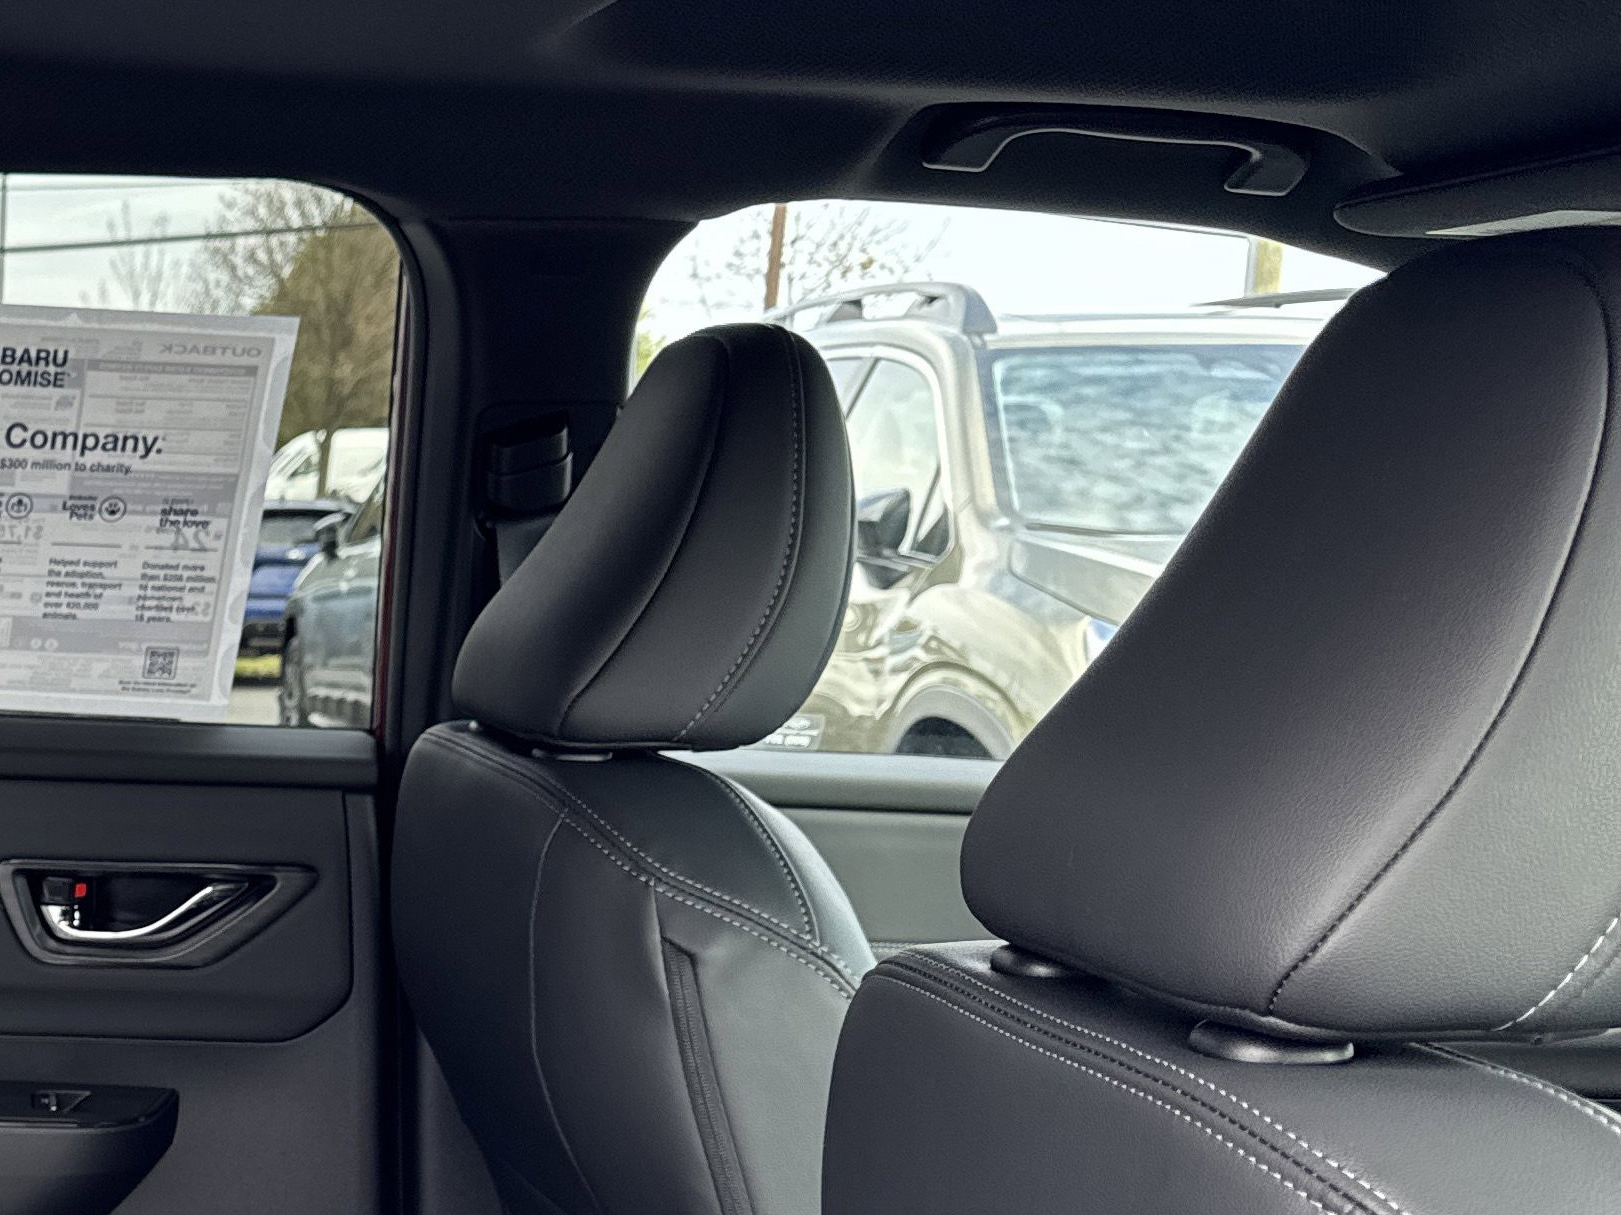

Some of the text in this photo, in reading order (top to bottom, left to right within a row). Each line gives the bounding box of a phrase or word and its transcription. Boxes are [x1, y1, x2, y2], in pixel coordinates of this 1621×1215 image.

[5, 422, 164, 460] Company.
[0, 457, 28, 471] $300
[31, 459, 71, 472] million
[75, 460, 86, 472] to
[89, 462, 132, 476] charity.
[62, 501, 95, 512] Loves
[160, 506, 199, 517] share
[69, 510, 95, 521] Pets
[159, 517, 212, 530] the love
